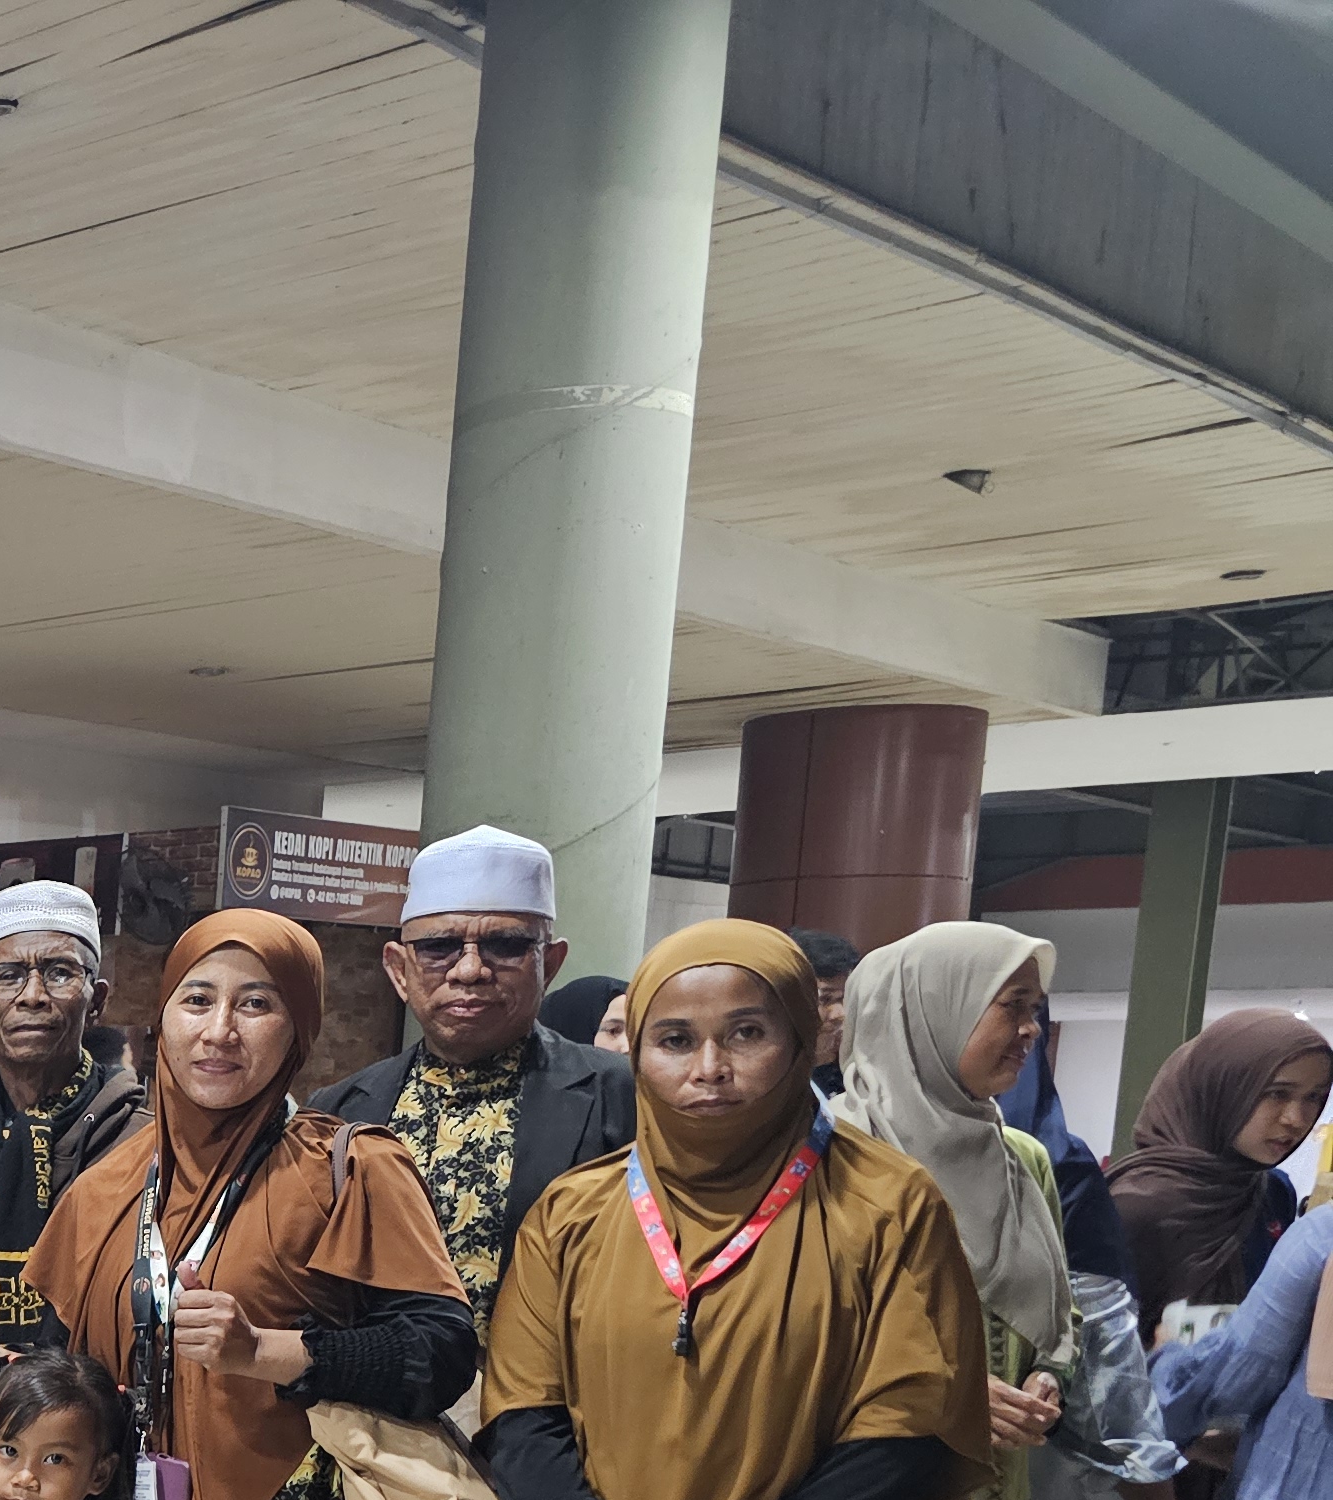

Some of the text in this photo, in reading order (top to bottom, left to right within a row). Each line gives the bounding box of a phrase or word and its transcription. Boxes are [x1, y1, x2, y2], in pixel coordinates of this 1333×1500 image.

[274, 830, 306, 857] KEDAI
[308, 835, 333, 860] KOPI
[335, 839, 384, 866] AUTENTIK
